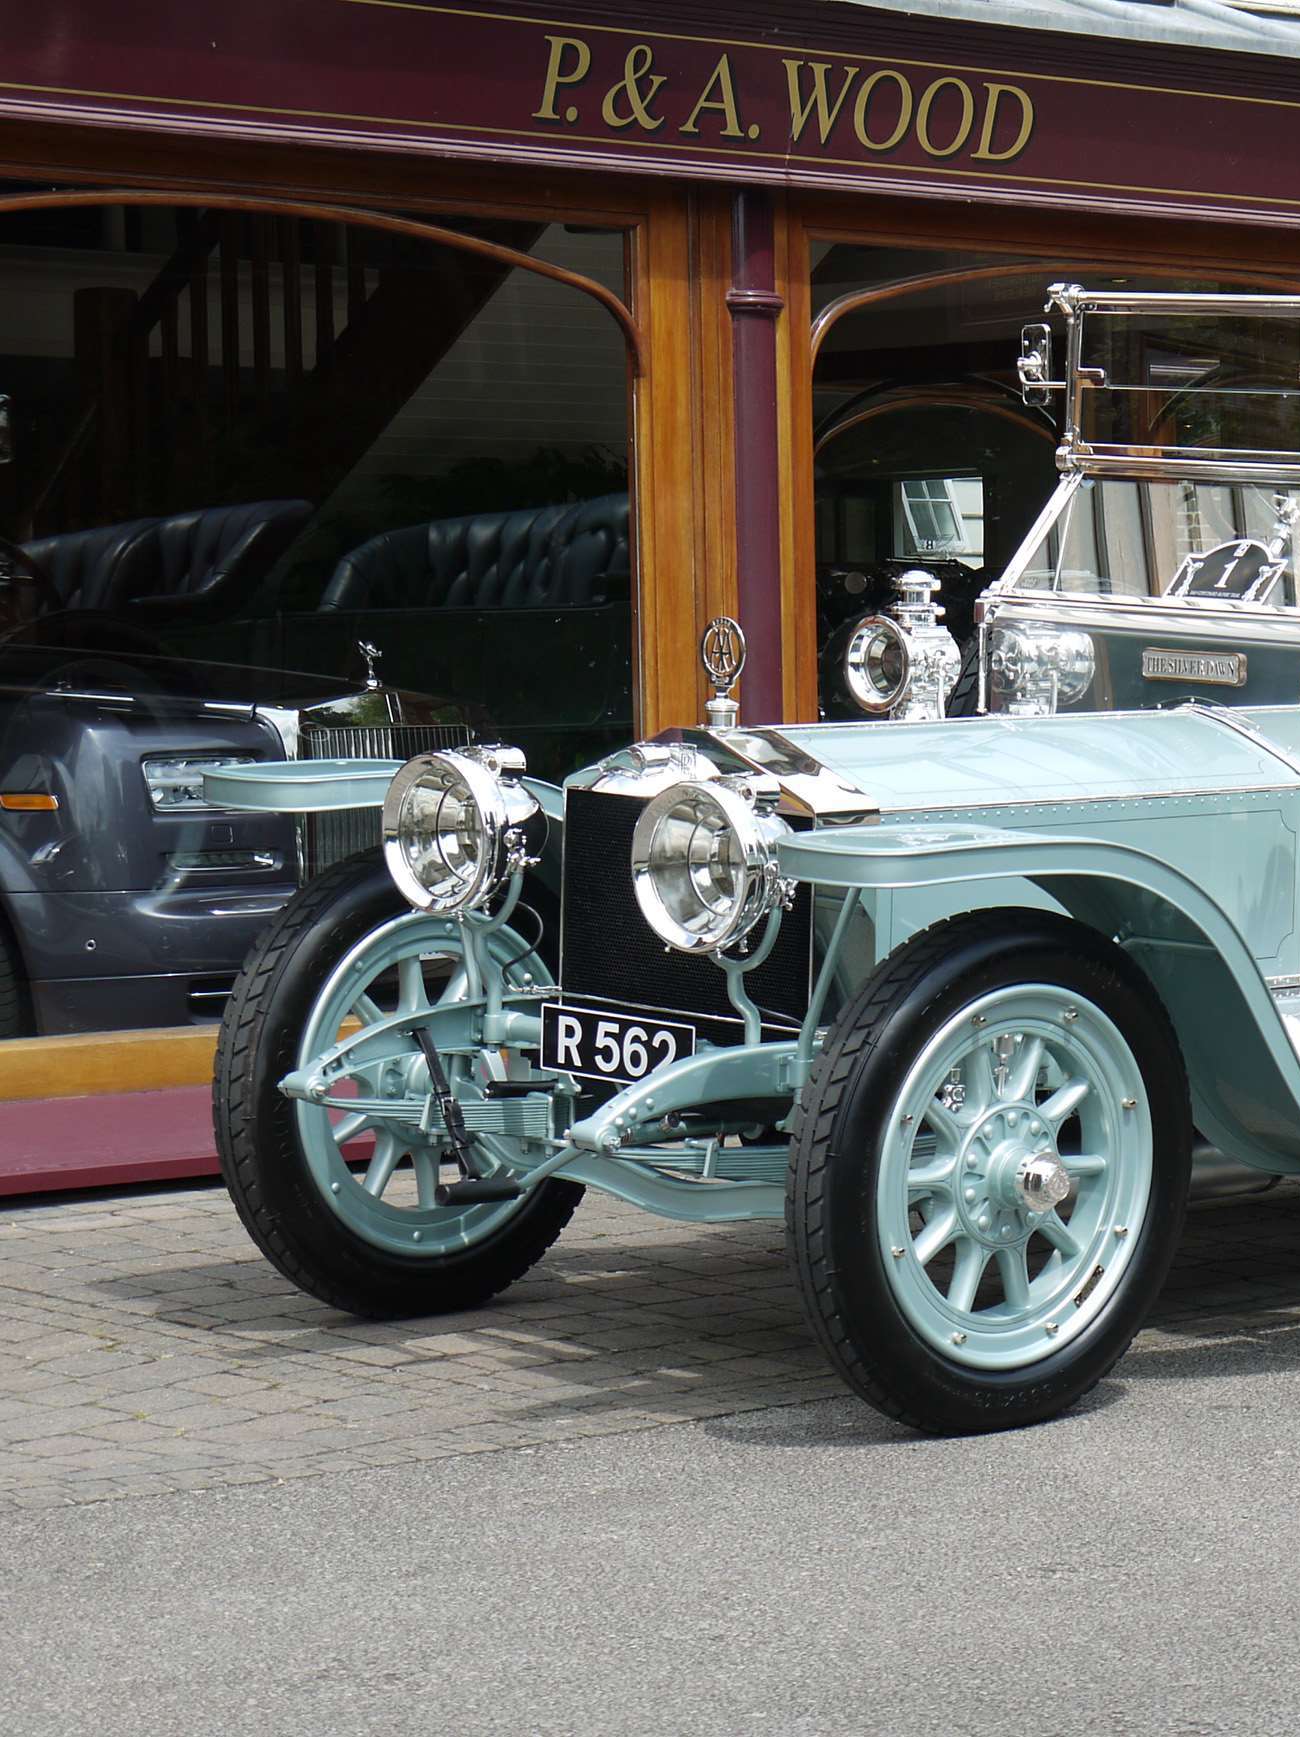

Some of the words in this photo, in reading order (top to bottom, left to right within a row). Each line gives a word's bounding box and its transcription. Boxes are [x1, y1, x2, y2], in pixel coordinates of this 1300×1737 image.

[531, 35, 591, 123] P.
[602, 44, 668, 131] &
[679, 53, 760, 140] A.
[782, 59, 1034, 161] WOOD
[1147, 656, 1166, 673] THE
[1167, 657, 1206, 676] SILVER
[1206, 659, 1235, 677] DAWN
[557, 1015, 582, 1067] R
[594, 1021, 677, 1077] 562
